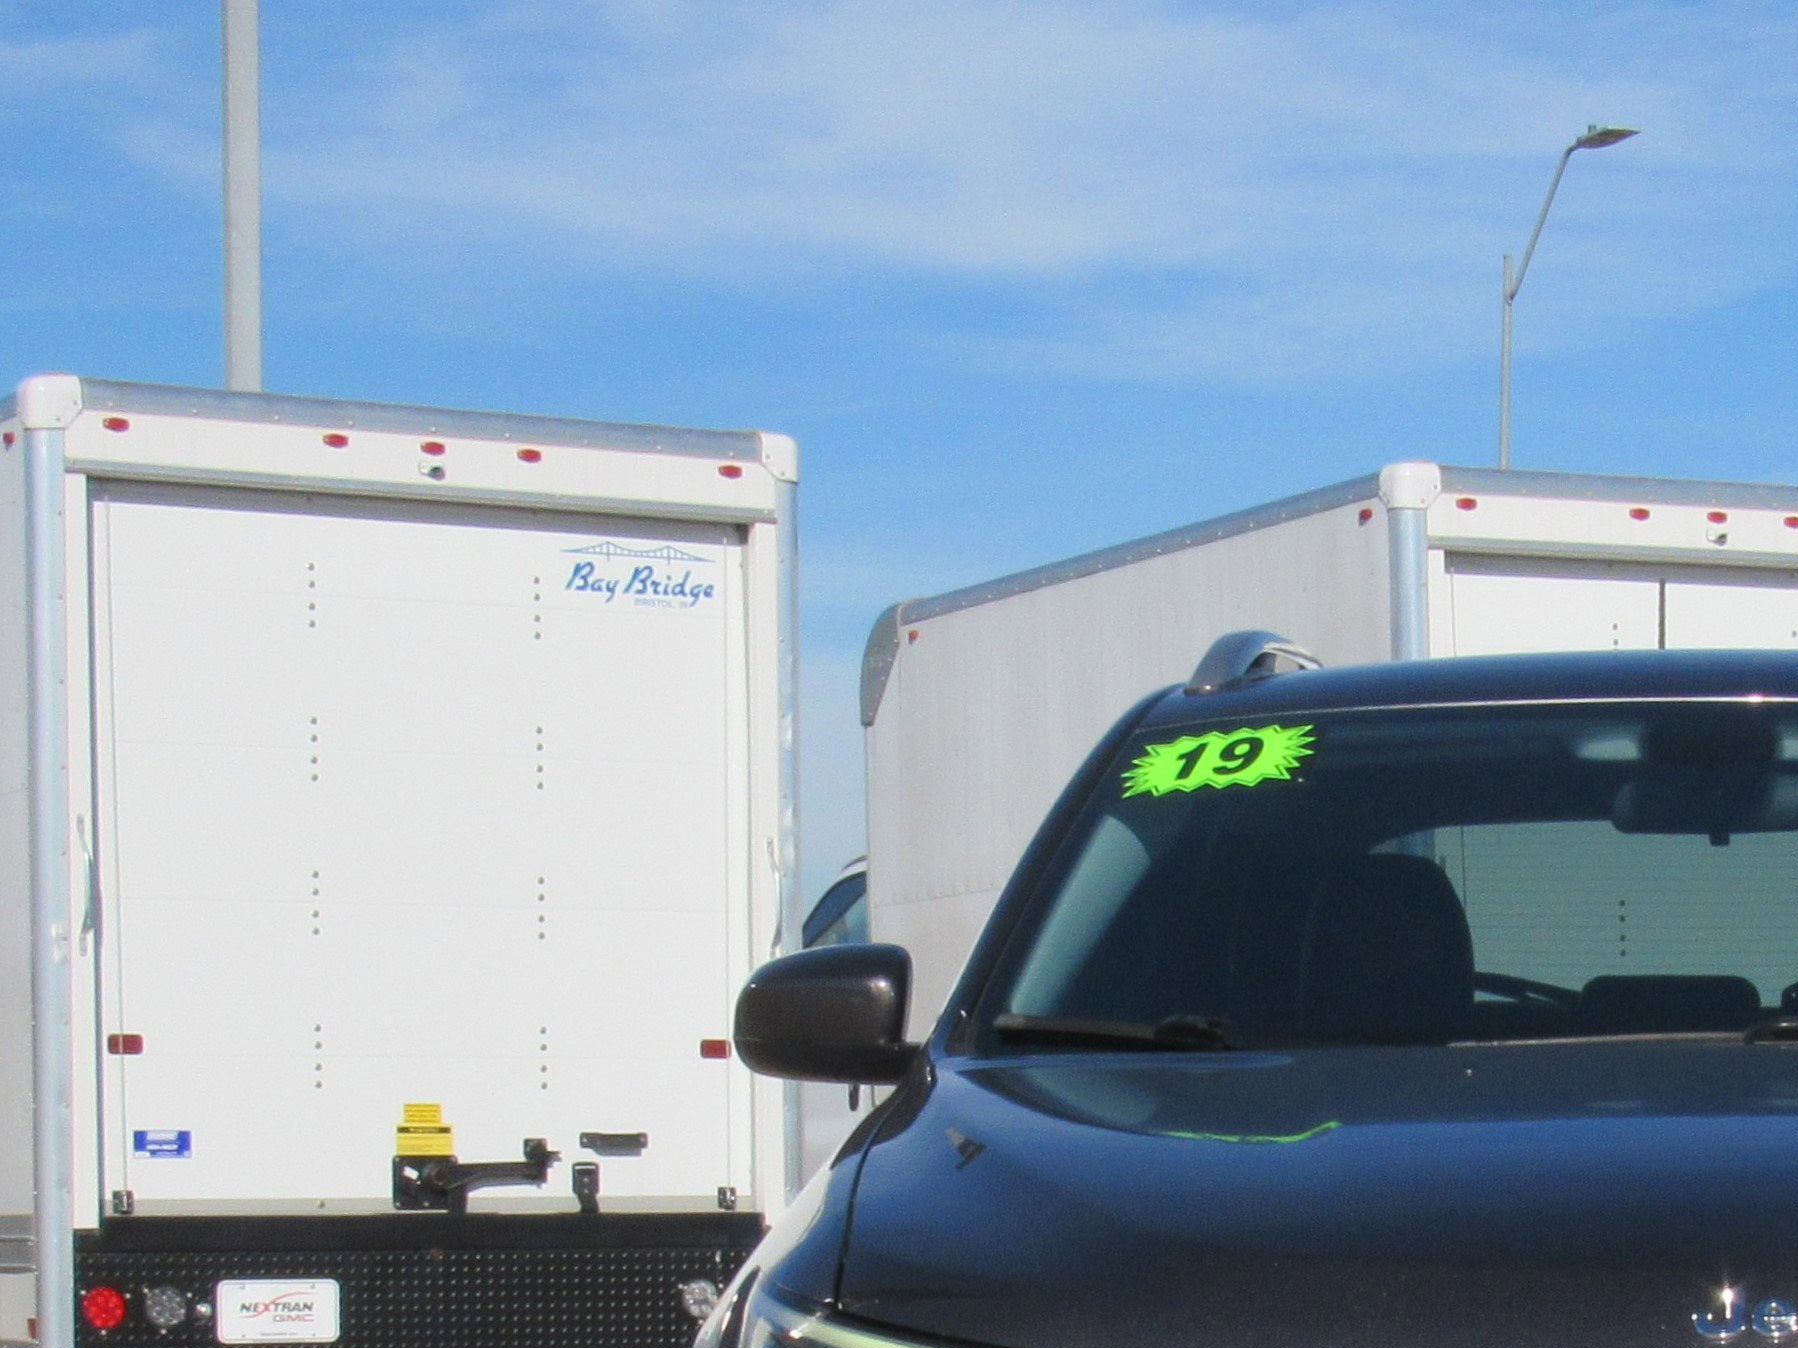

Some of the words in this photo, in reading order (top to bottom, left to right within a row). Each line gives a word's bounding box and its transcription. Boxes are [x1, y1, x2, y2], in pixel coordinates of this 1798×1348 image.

[565, 561, 619, 603] Bay
[622, 565, 715, 608] Bridge
[1174, 736, 1265, 781] 19
[240, 1302, 314, 1312] NEXTRAN
[273, 1313, 315, 1322] GMC
